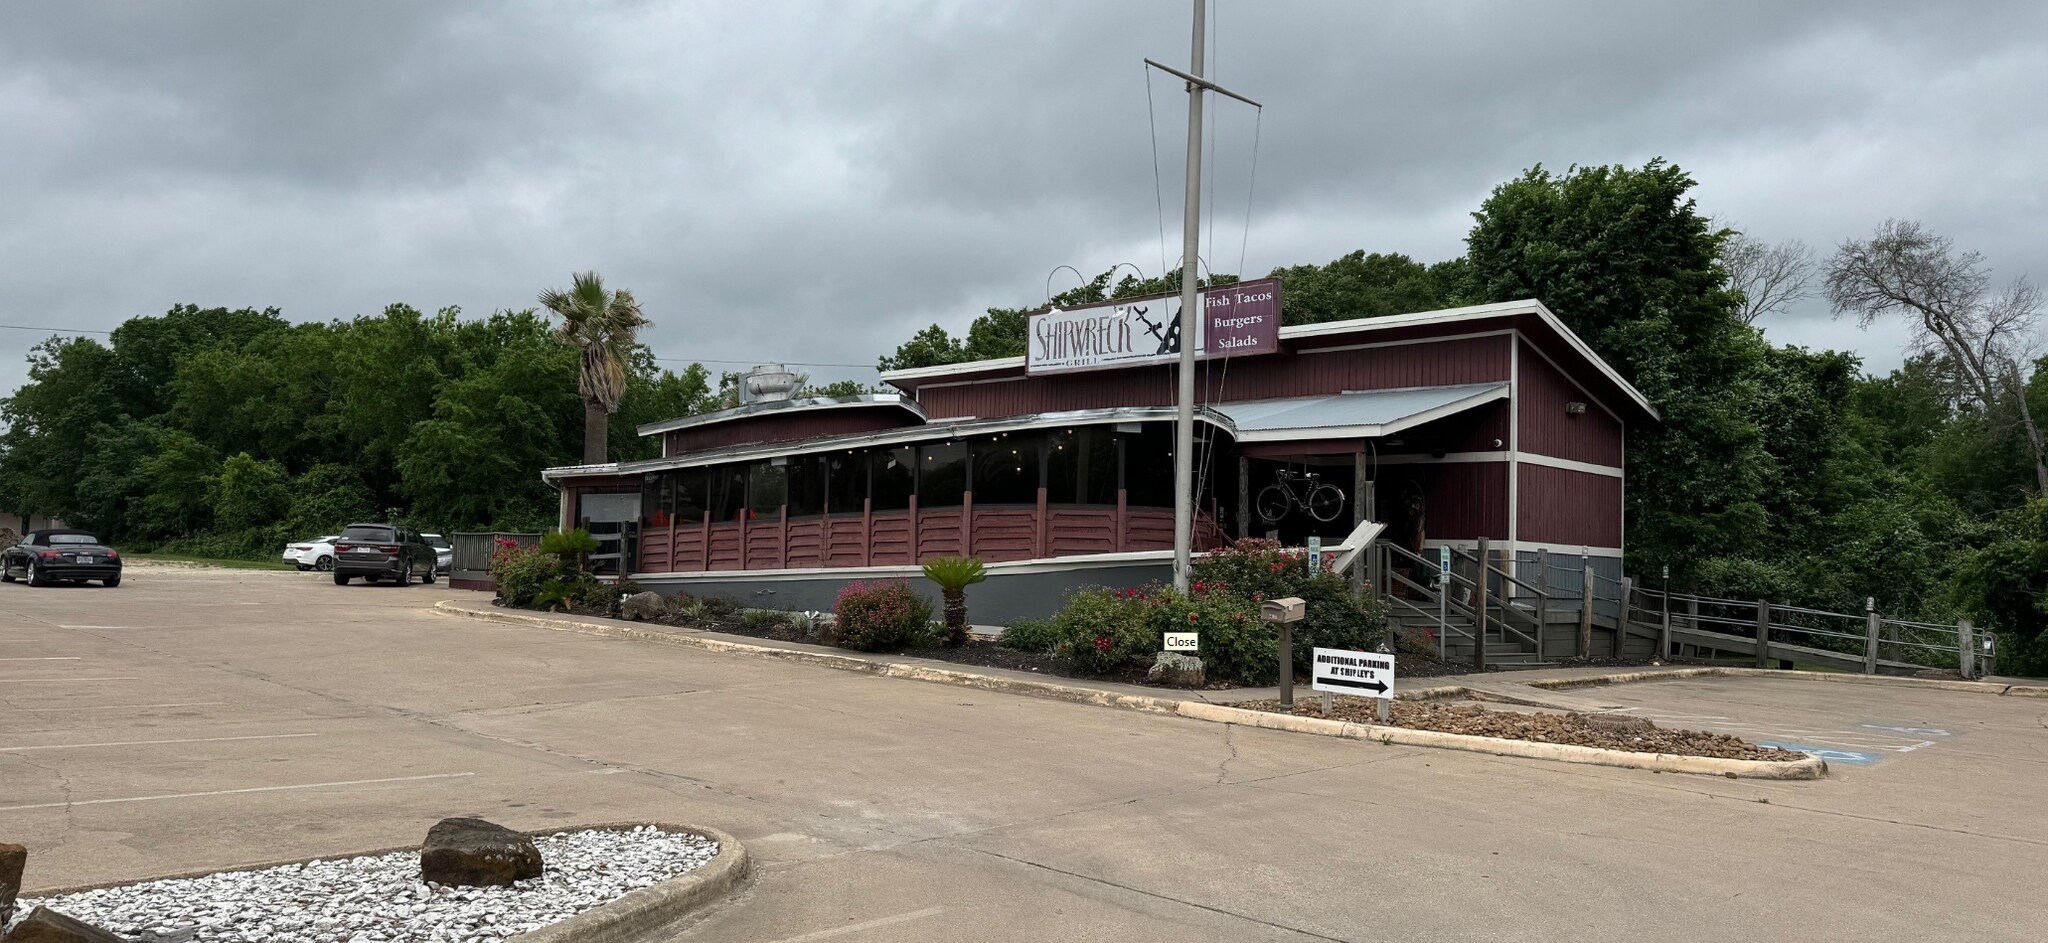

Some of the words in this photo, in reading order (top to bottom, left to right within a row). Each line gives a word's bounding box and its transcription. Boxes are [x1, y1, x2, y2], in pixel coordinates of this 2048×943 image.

[1205, 294, 1230, 308] Fish
[1234, 291, 1272, 304] Tacos
[1214, 315, 1263, 329] Burgers
[1035, 306, 1133, 361] SHIPWRECK
[1218, 334, 1258, 349] Salads
[1065, 357, 1100, 367] GRILL
[1317, 654, 1358, 667] ADDITIONAL
[1358, 658, 1390, 670] PARKING
[1330, 666, 1340, 676] AT
